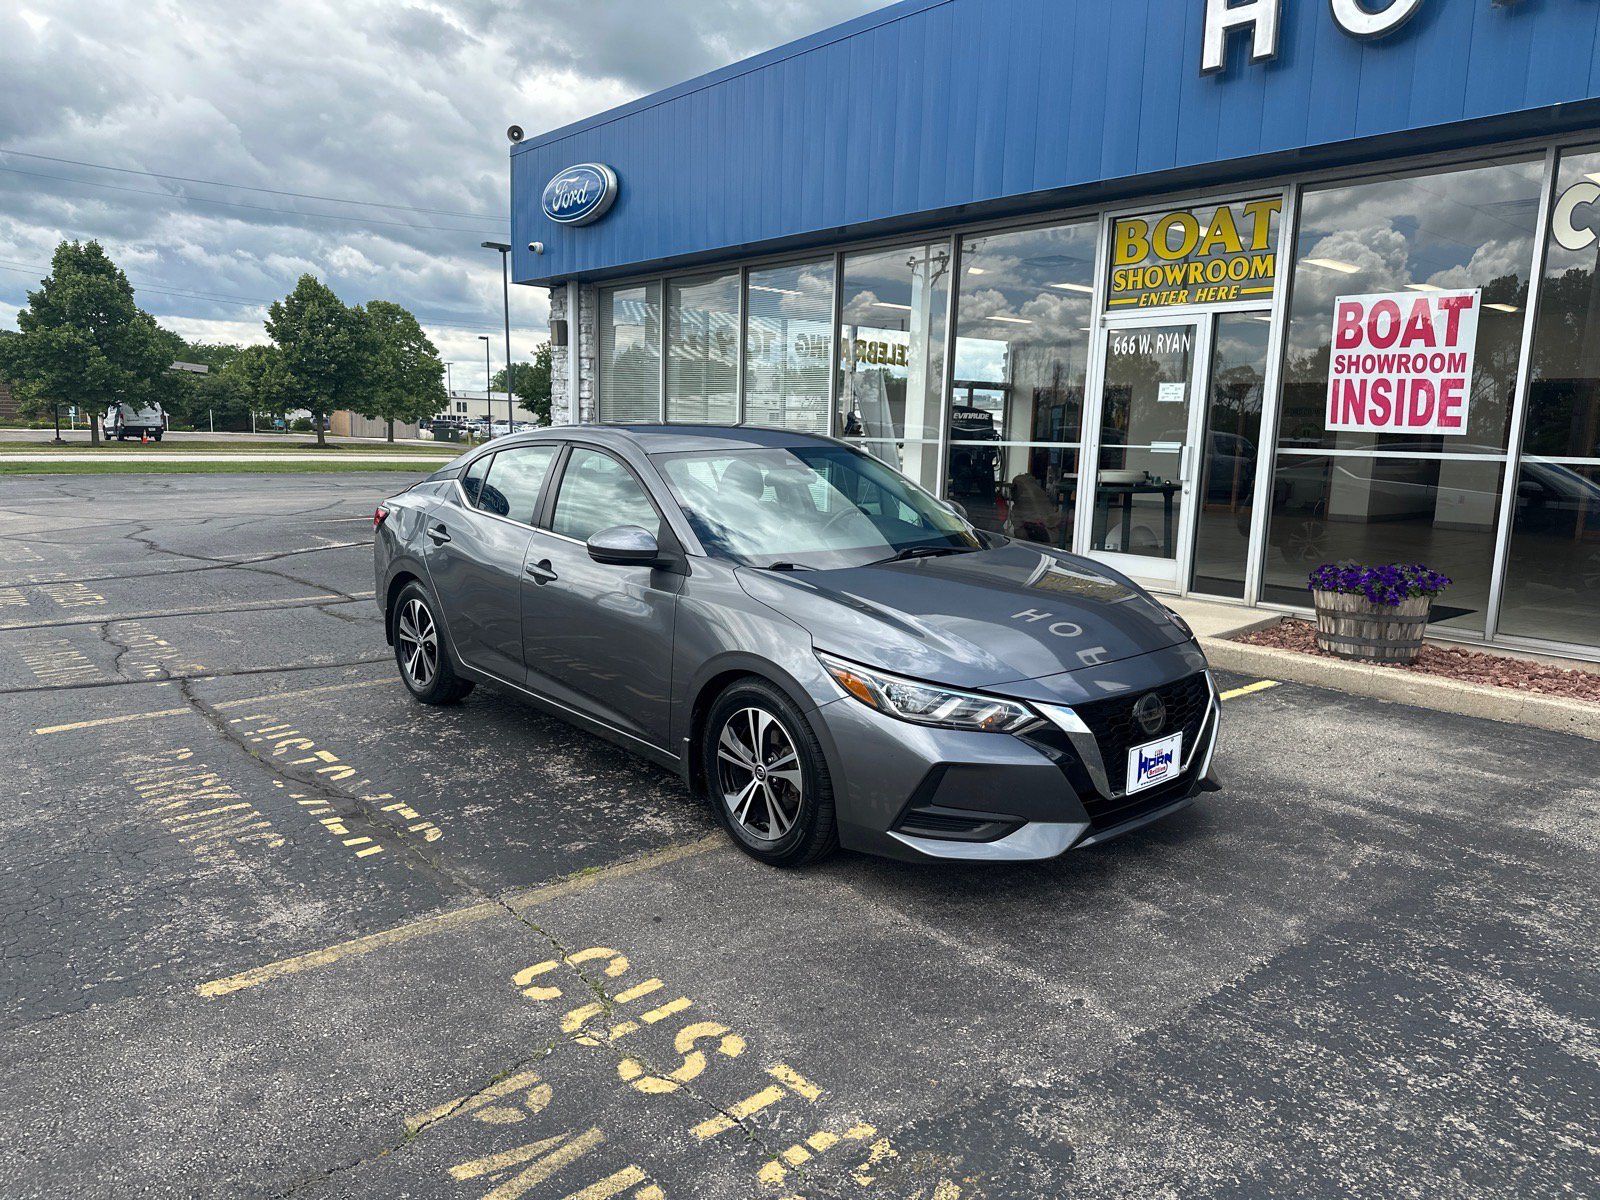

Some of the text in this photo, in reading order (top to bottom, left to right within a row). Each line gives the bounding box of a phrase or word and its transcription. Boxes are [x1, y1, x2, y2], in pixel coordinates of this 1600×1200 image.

[553, 176, 589, 212] Ford
[1113, 199, 1283, 266] BOAT
[1113, 254, 1275, 292] SHOWROOM
[1138, 285, 1240, 307] ENTER HERE
[1336, 296, 1474, 350] BOAT
[1113, 332, 1191, 356] 666 W. RYAN
[1334, 353, 1467, 374] SHOWROOM
[1330, 378, 1465, 427] INSIDE
[1137, 749, 1174, 784] HORN
